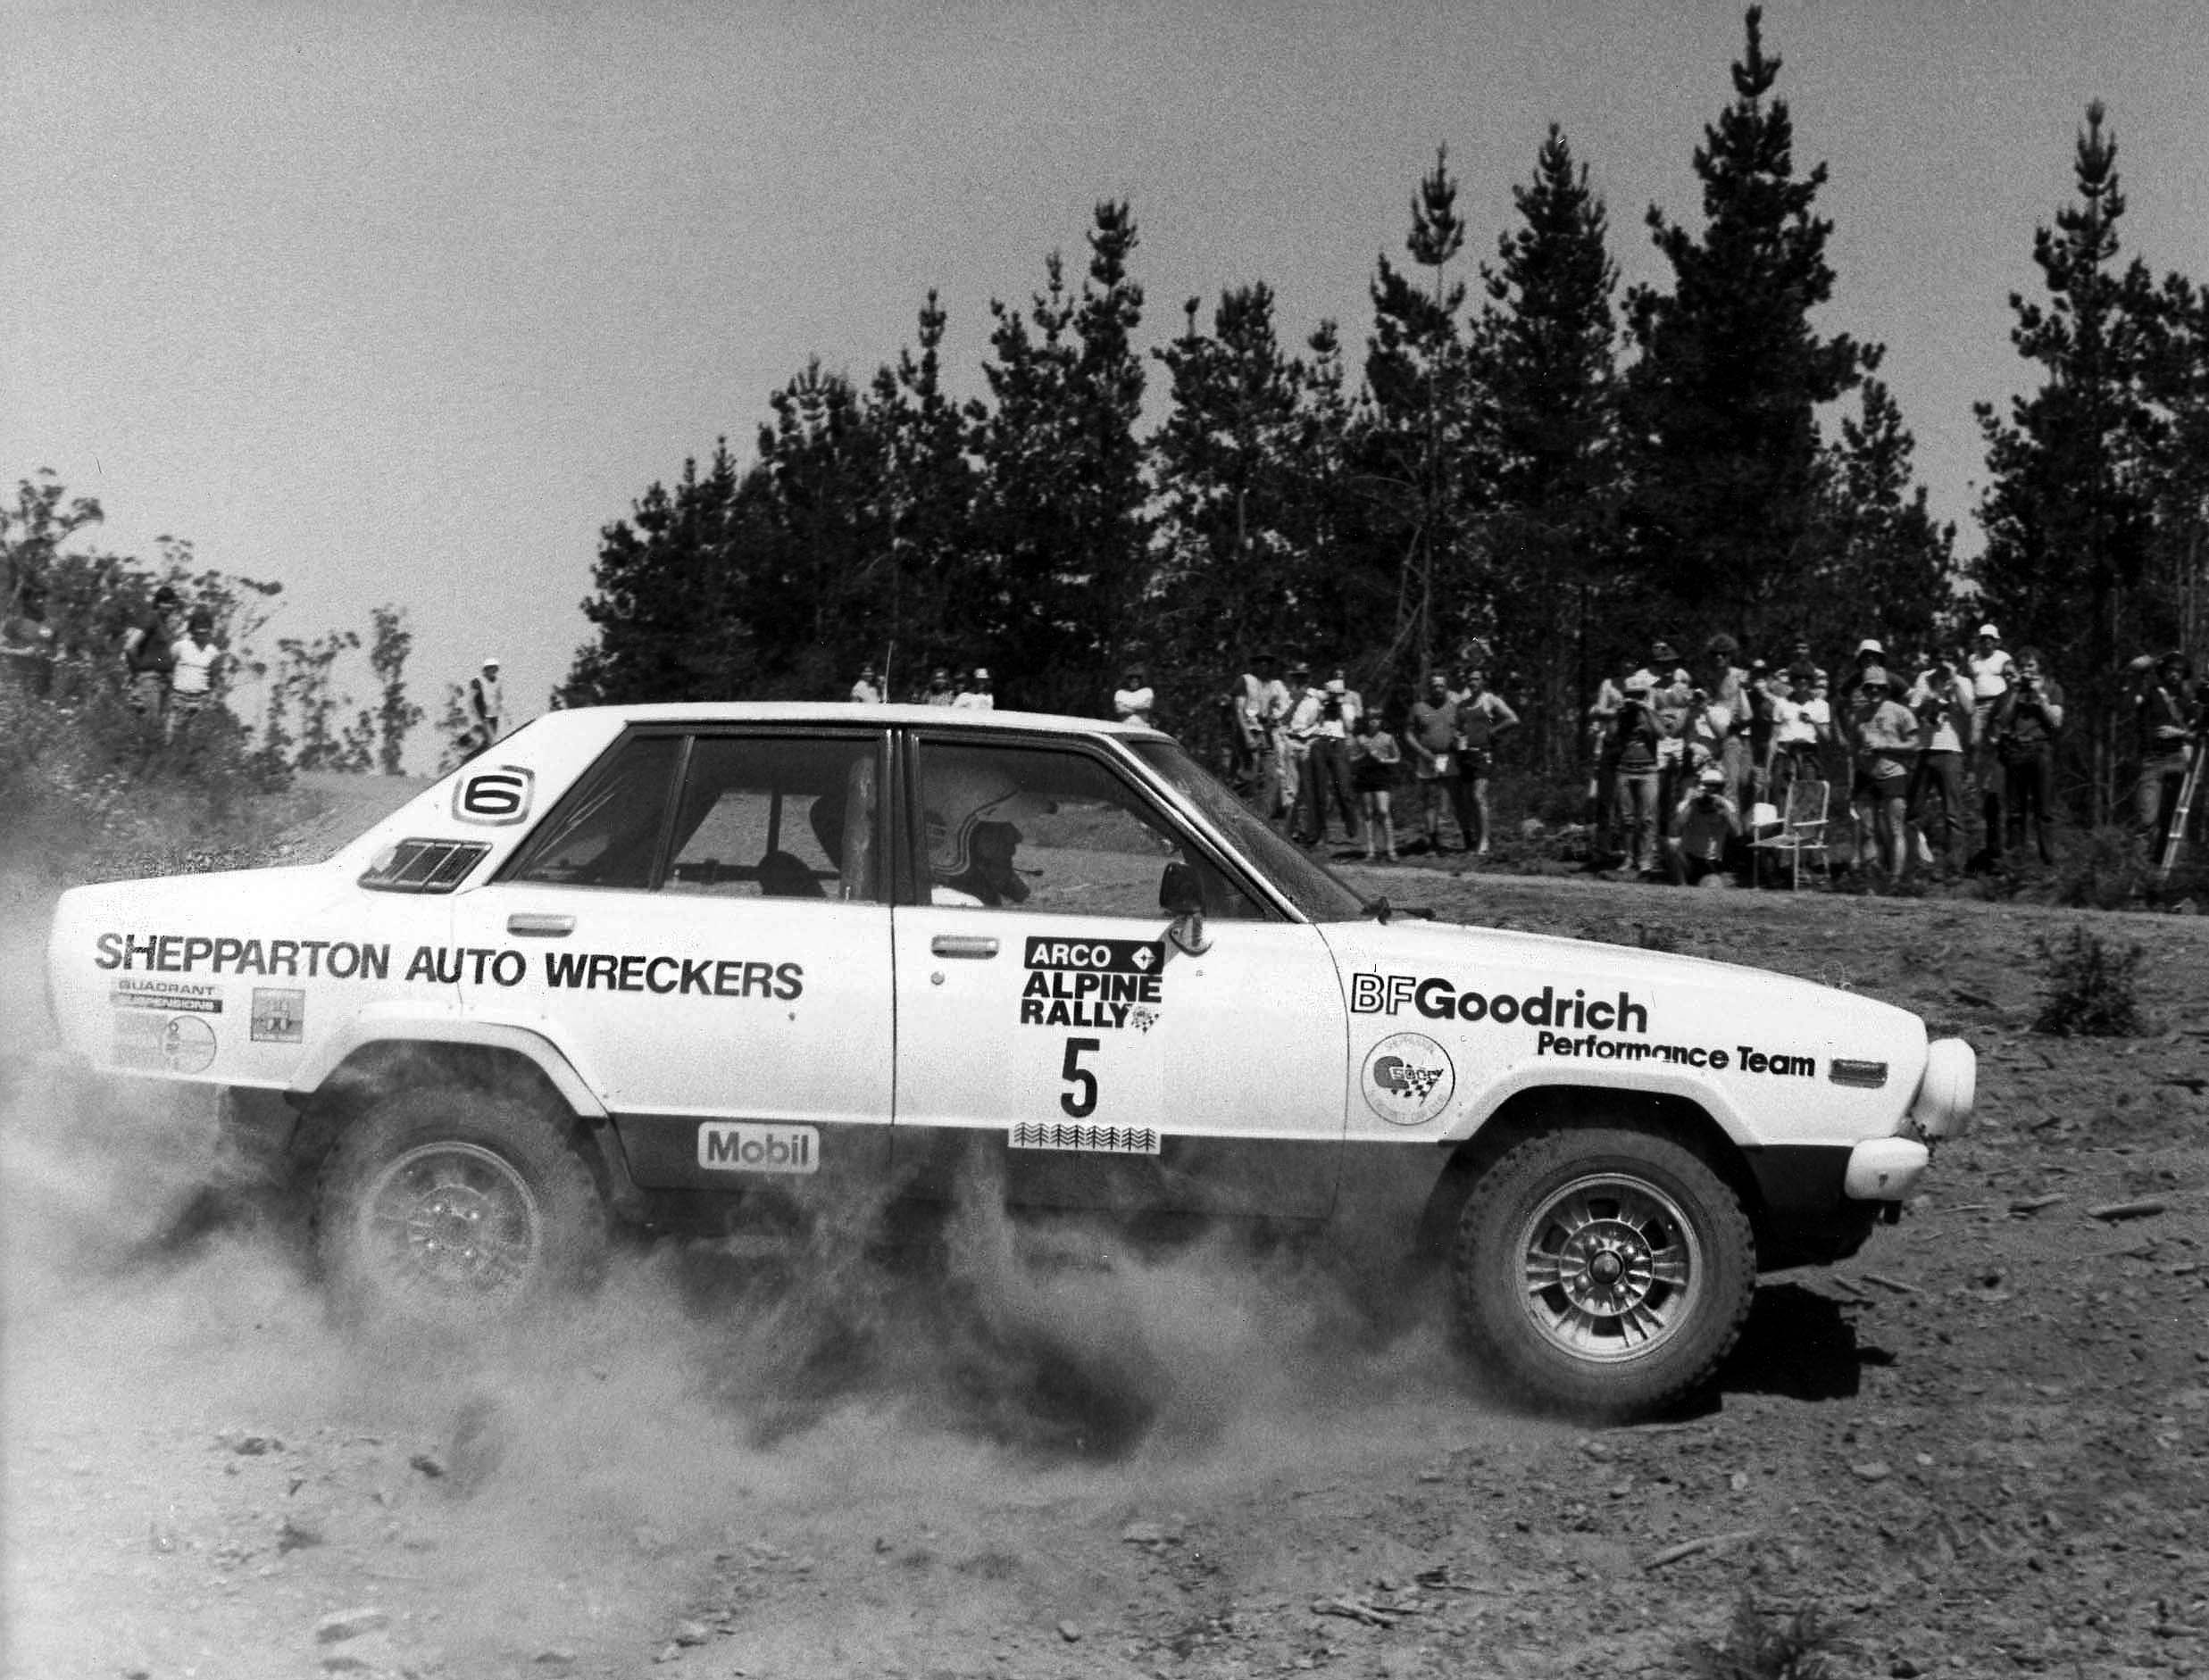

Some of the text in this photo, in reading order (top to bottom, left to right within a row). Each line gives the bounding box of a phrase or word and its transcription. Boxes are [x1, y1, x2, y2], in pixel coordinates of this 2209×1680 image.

[464, 775, 523, 814] 6
[94, 932, 804, 1000] SHEPPARTON AUTO WRECKERS
[1031, 943, 1112, 968] ARCO
[118, 978, 215, 995] QUADRANT
[1022, 971, 1163, 1002] ALPINE
[1350, 972, 1648, 1033] BFGoodrich
[1021, 999, 1133, 1028] RALLY
[1538, 1031, 1816, 1077] Performance Team
[1060, 1037, 1100, 1119] 5
[707, 1130, 810, 1166] Mobil
